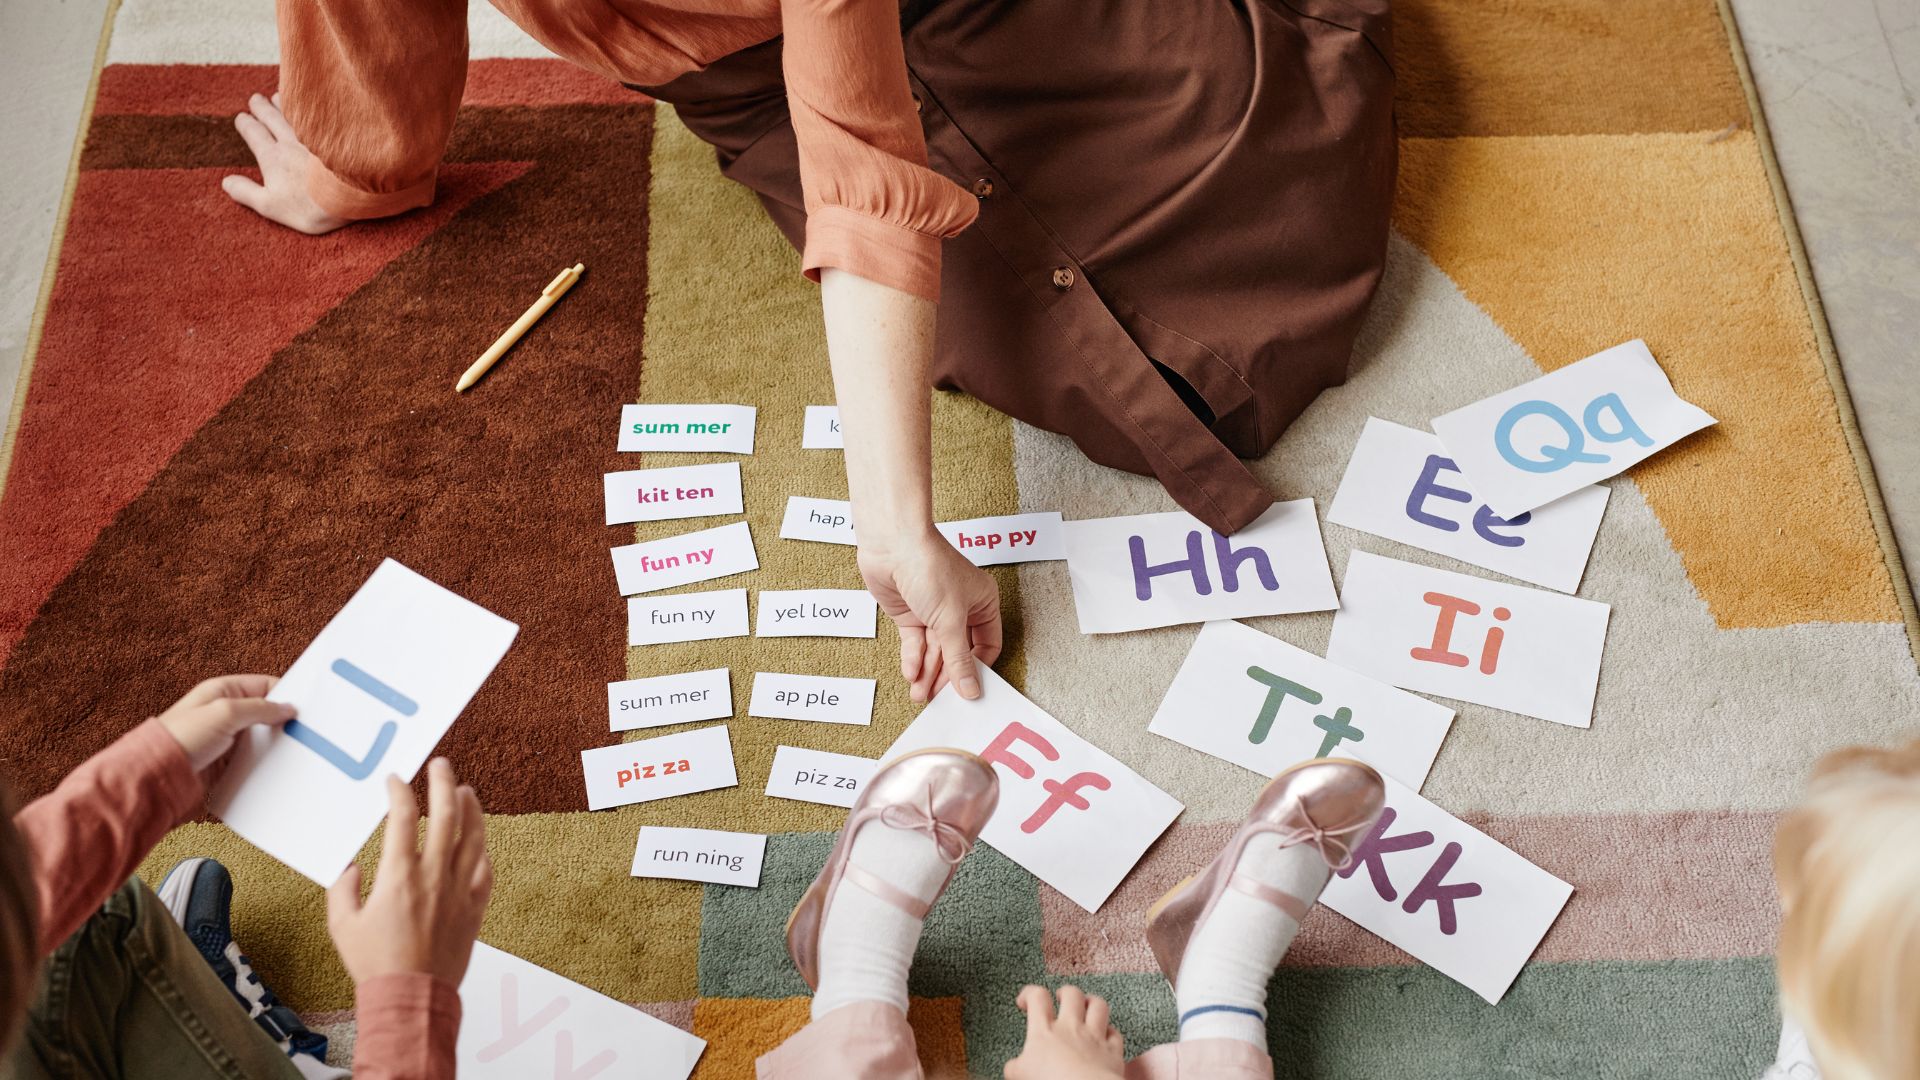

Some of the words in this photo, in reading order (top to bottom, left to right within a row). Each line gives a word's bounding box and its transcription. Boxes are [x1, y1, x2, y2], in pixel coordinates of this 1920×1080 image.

[632, 423, 680, 435] sum
[685, 422, 732, 435] mer
[637, 487, 669, 504] kit
[675, 486, 714, 501] ten
[1405, 454, 1531, 548] Ee
[809, 509, 846, 529] hap
[958, 532, 1002, 550] hap
[1008, 529, 1037, 548] py
[640, 555, 681, 574] fun
[685, 547, 715, 565] ny
[1128, 529, 1279, 601] Hh
[651, 609, 685, 625] fun
[691, 608, 716, 624] ny
[775, 603, 806, 623] yel
[812, 602, 850, 619] low
[619, 695, 663, 711] sum
[669, 687, 711, 705] mer
[774, 690, 800, 707] ap
[805, 689, 841, 708] ple
[1246, 665, 1364, 759] Tt
[616, 762, 657, 788] piz
[662, 757, 691, 774] za
[794, 768, 828, 786] piz
[833, 776, 857, 791] za
[978, 721, 1111, 834] Ff
[653, 848, 689, 863] run
[695, 849, 745, 872] ning
